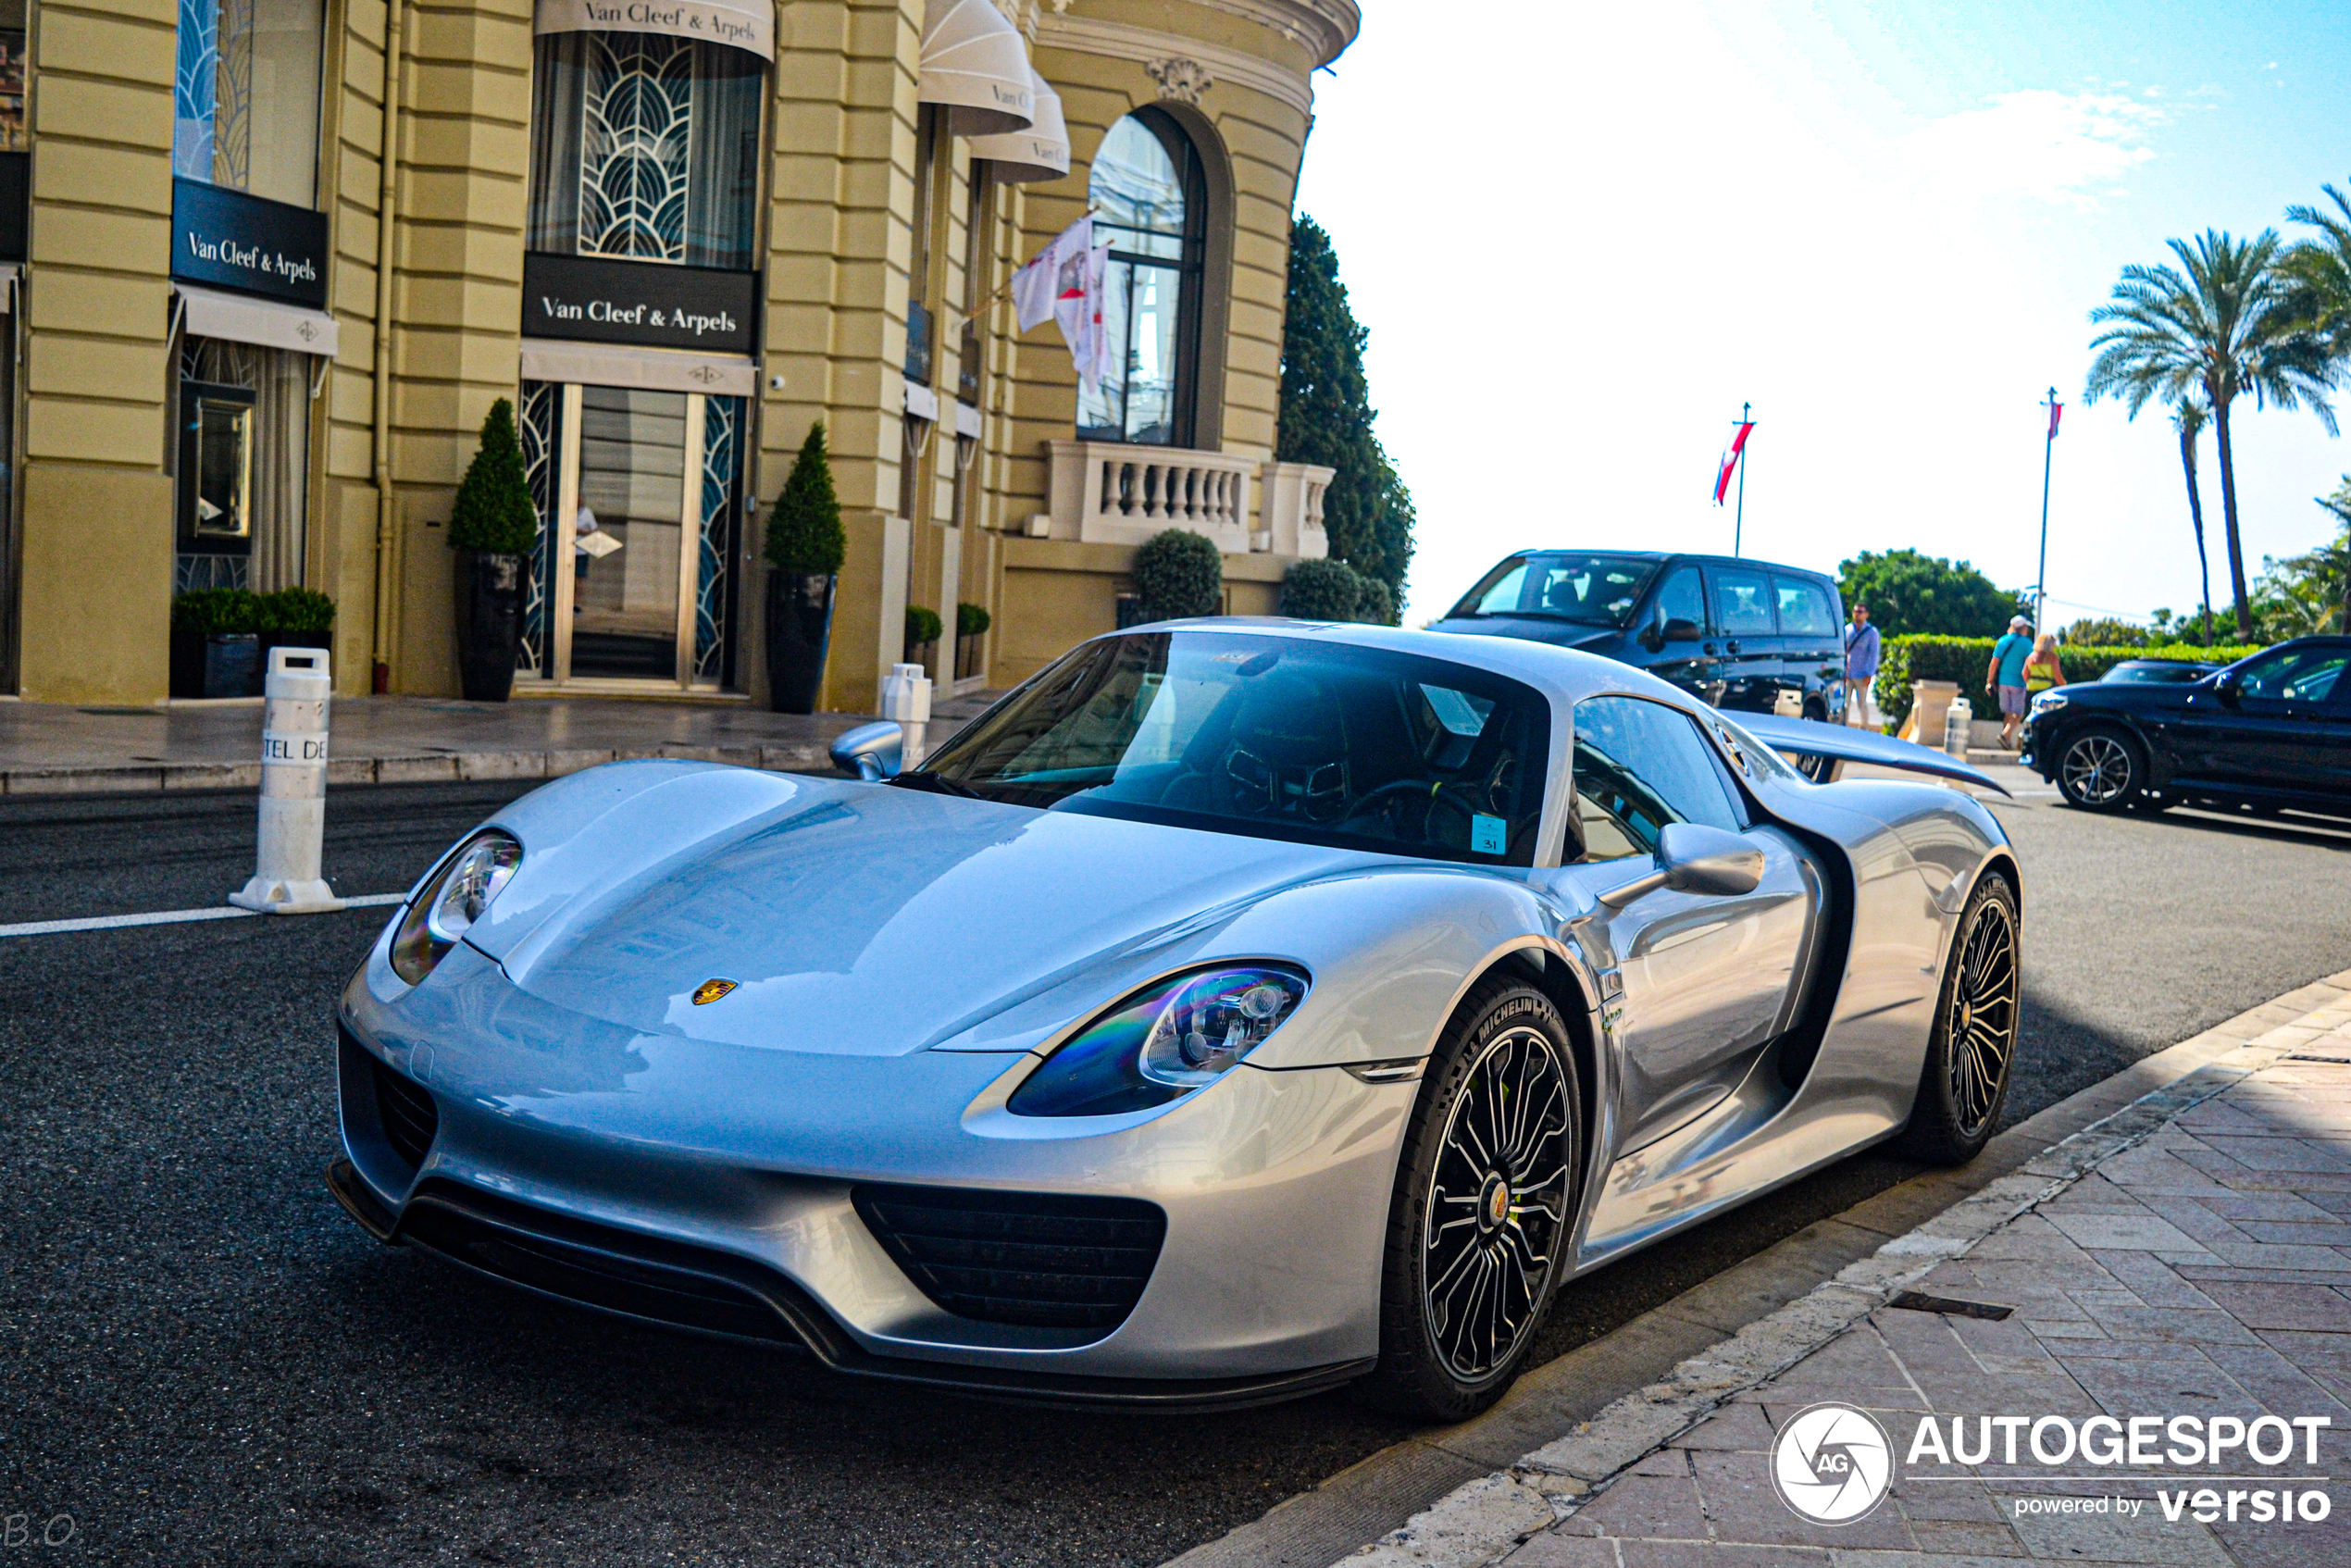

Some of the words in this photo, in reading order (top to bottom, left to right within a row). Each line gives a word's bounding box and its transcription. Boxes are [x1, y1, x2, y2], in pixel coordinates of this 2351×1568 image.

[585, 2, 621, 22] Van
[628, 4, 684, 26] Cleef
[689, 15, 703, 30] &
[708, 14, 756, 42] Arpels
[189, 231, 218, 261] Van
[219, 239, 259, 269] Cleef
[261, 253, 272, 272] &
[275, 253, 317, 284] Arpels
[541, 296, 583, 320] Van
[587, 300, 647, 325] Cleef
[650, 309, 665, 327] &
[670, 307, 737, 336] Arpels
[265, 739, 294, 759] TEL
[304, 740, 326, 759] DE
[1483, 839, 1497, 851] 31
[1479, 998, 1533, 1043] MICHELIN
[1410, 1219, 1422, 1258] Cup
